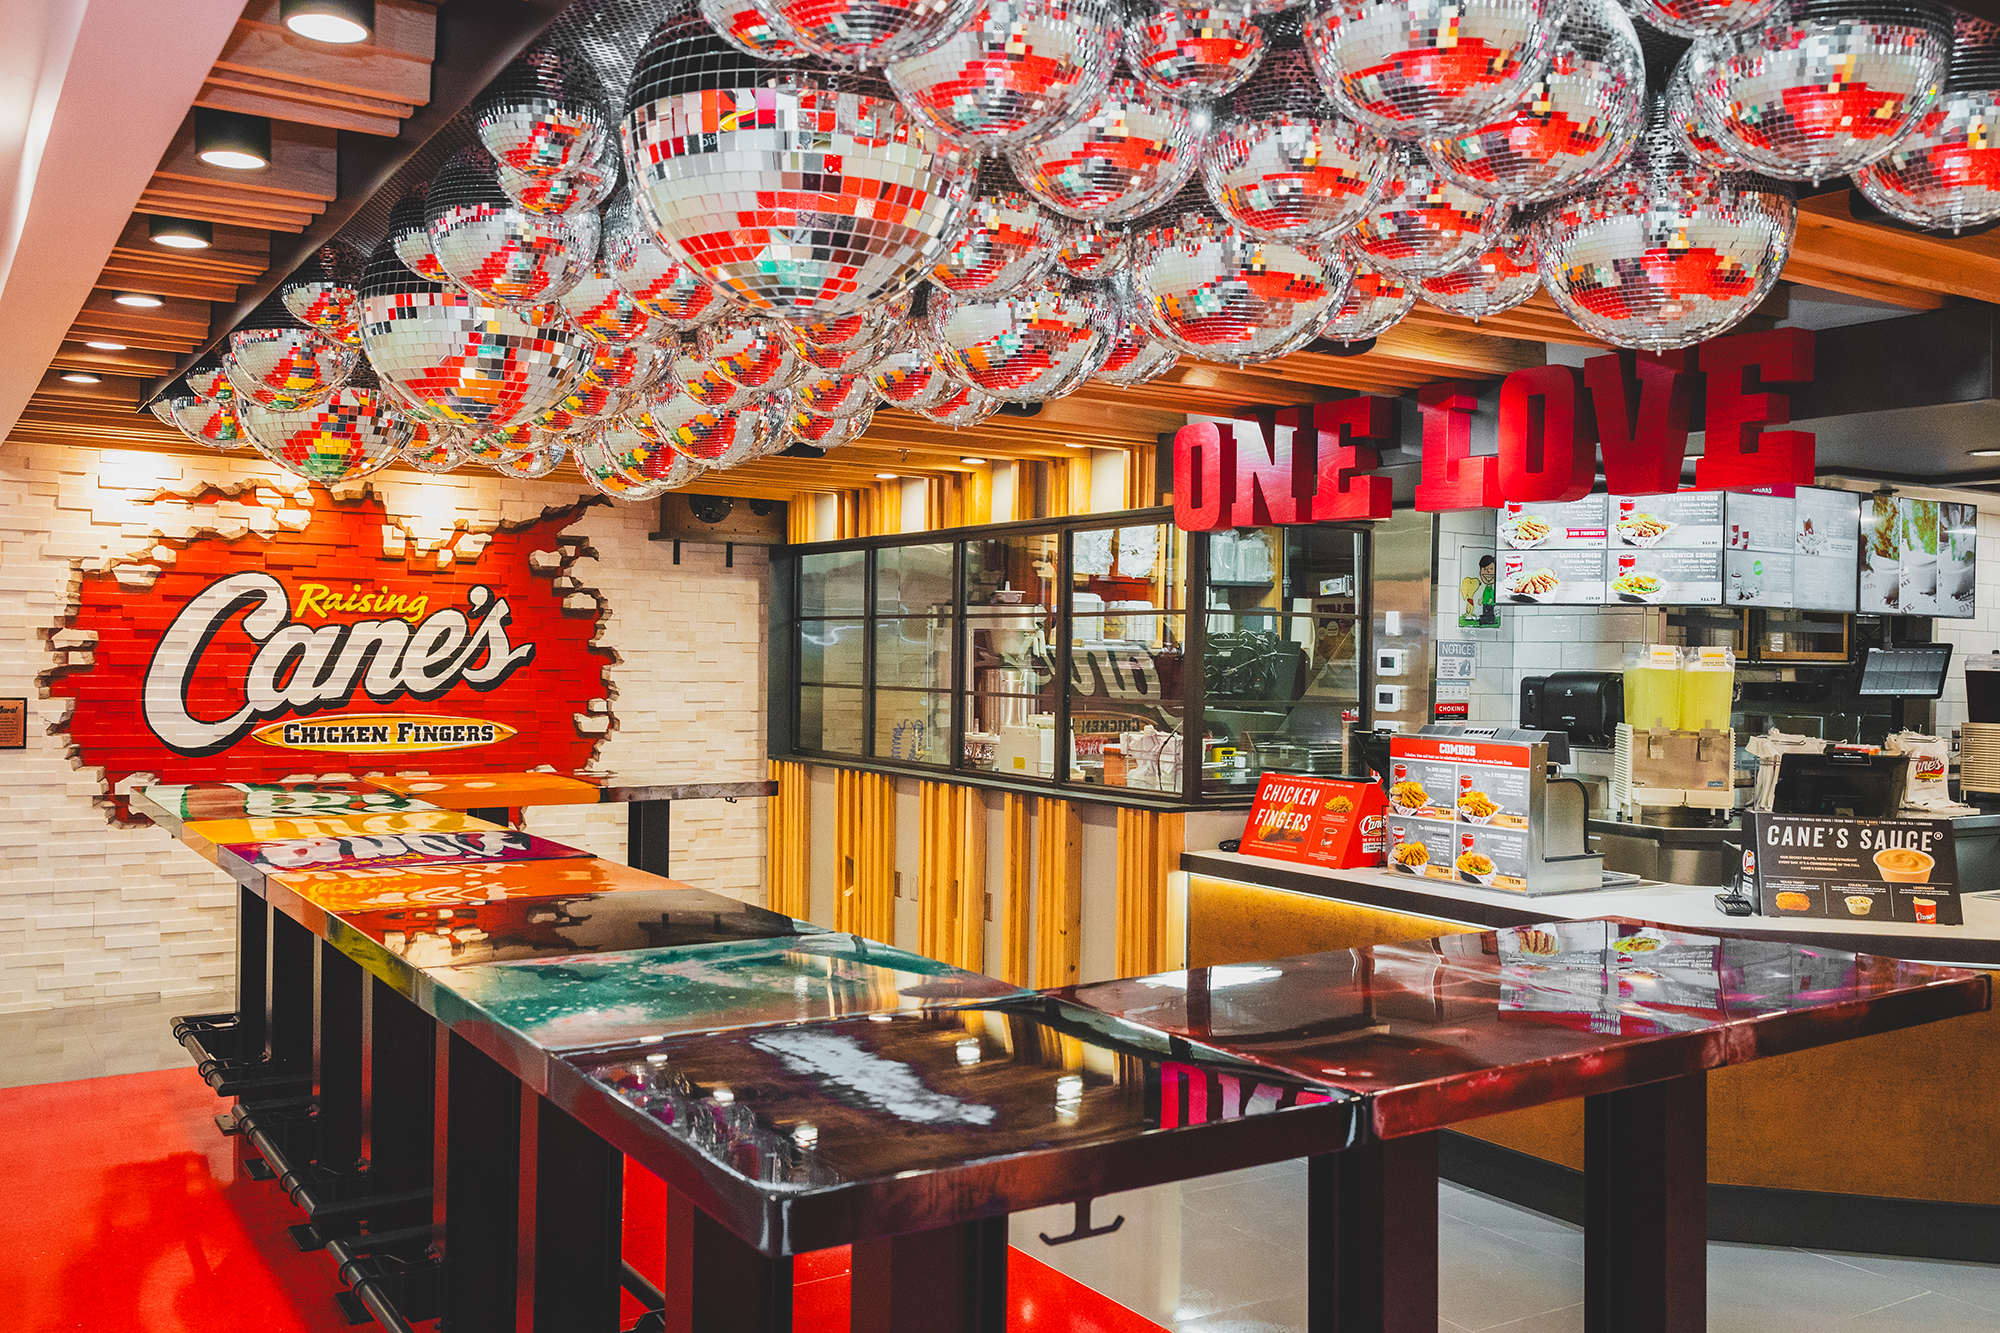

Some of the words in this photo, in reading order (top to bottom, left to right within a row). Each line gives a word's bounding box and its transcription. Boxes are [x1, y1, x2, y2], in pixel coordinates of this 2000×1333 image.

[1172, 395, 1393, 531] ONE
[1415, 326, 1815, 512] LOVE
[295, 583, 430, 623] Raising
[1442, 644, 1471, 655] NOTICE
[142, 570, 537, 758] Cane's
[1440, 743, 1476, 756] COMBOS
[1262, 784, 1320, 806] CHICKEN
[1254, 808, 1312, 831] FINGERS
[1767, 825, 1849, 848] CANE'S
